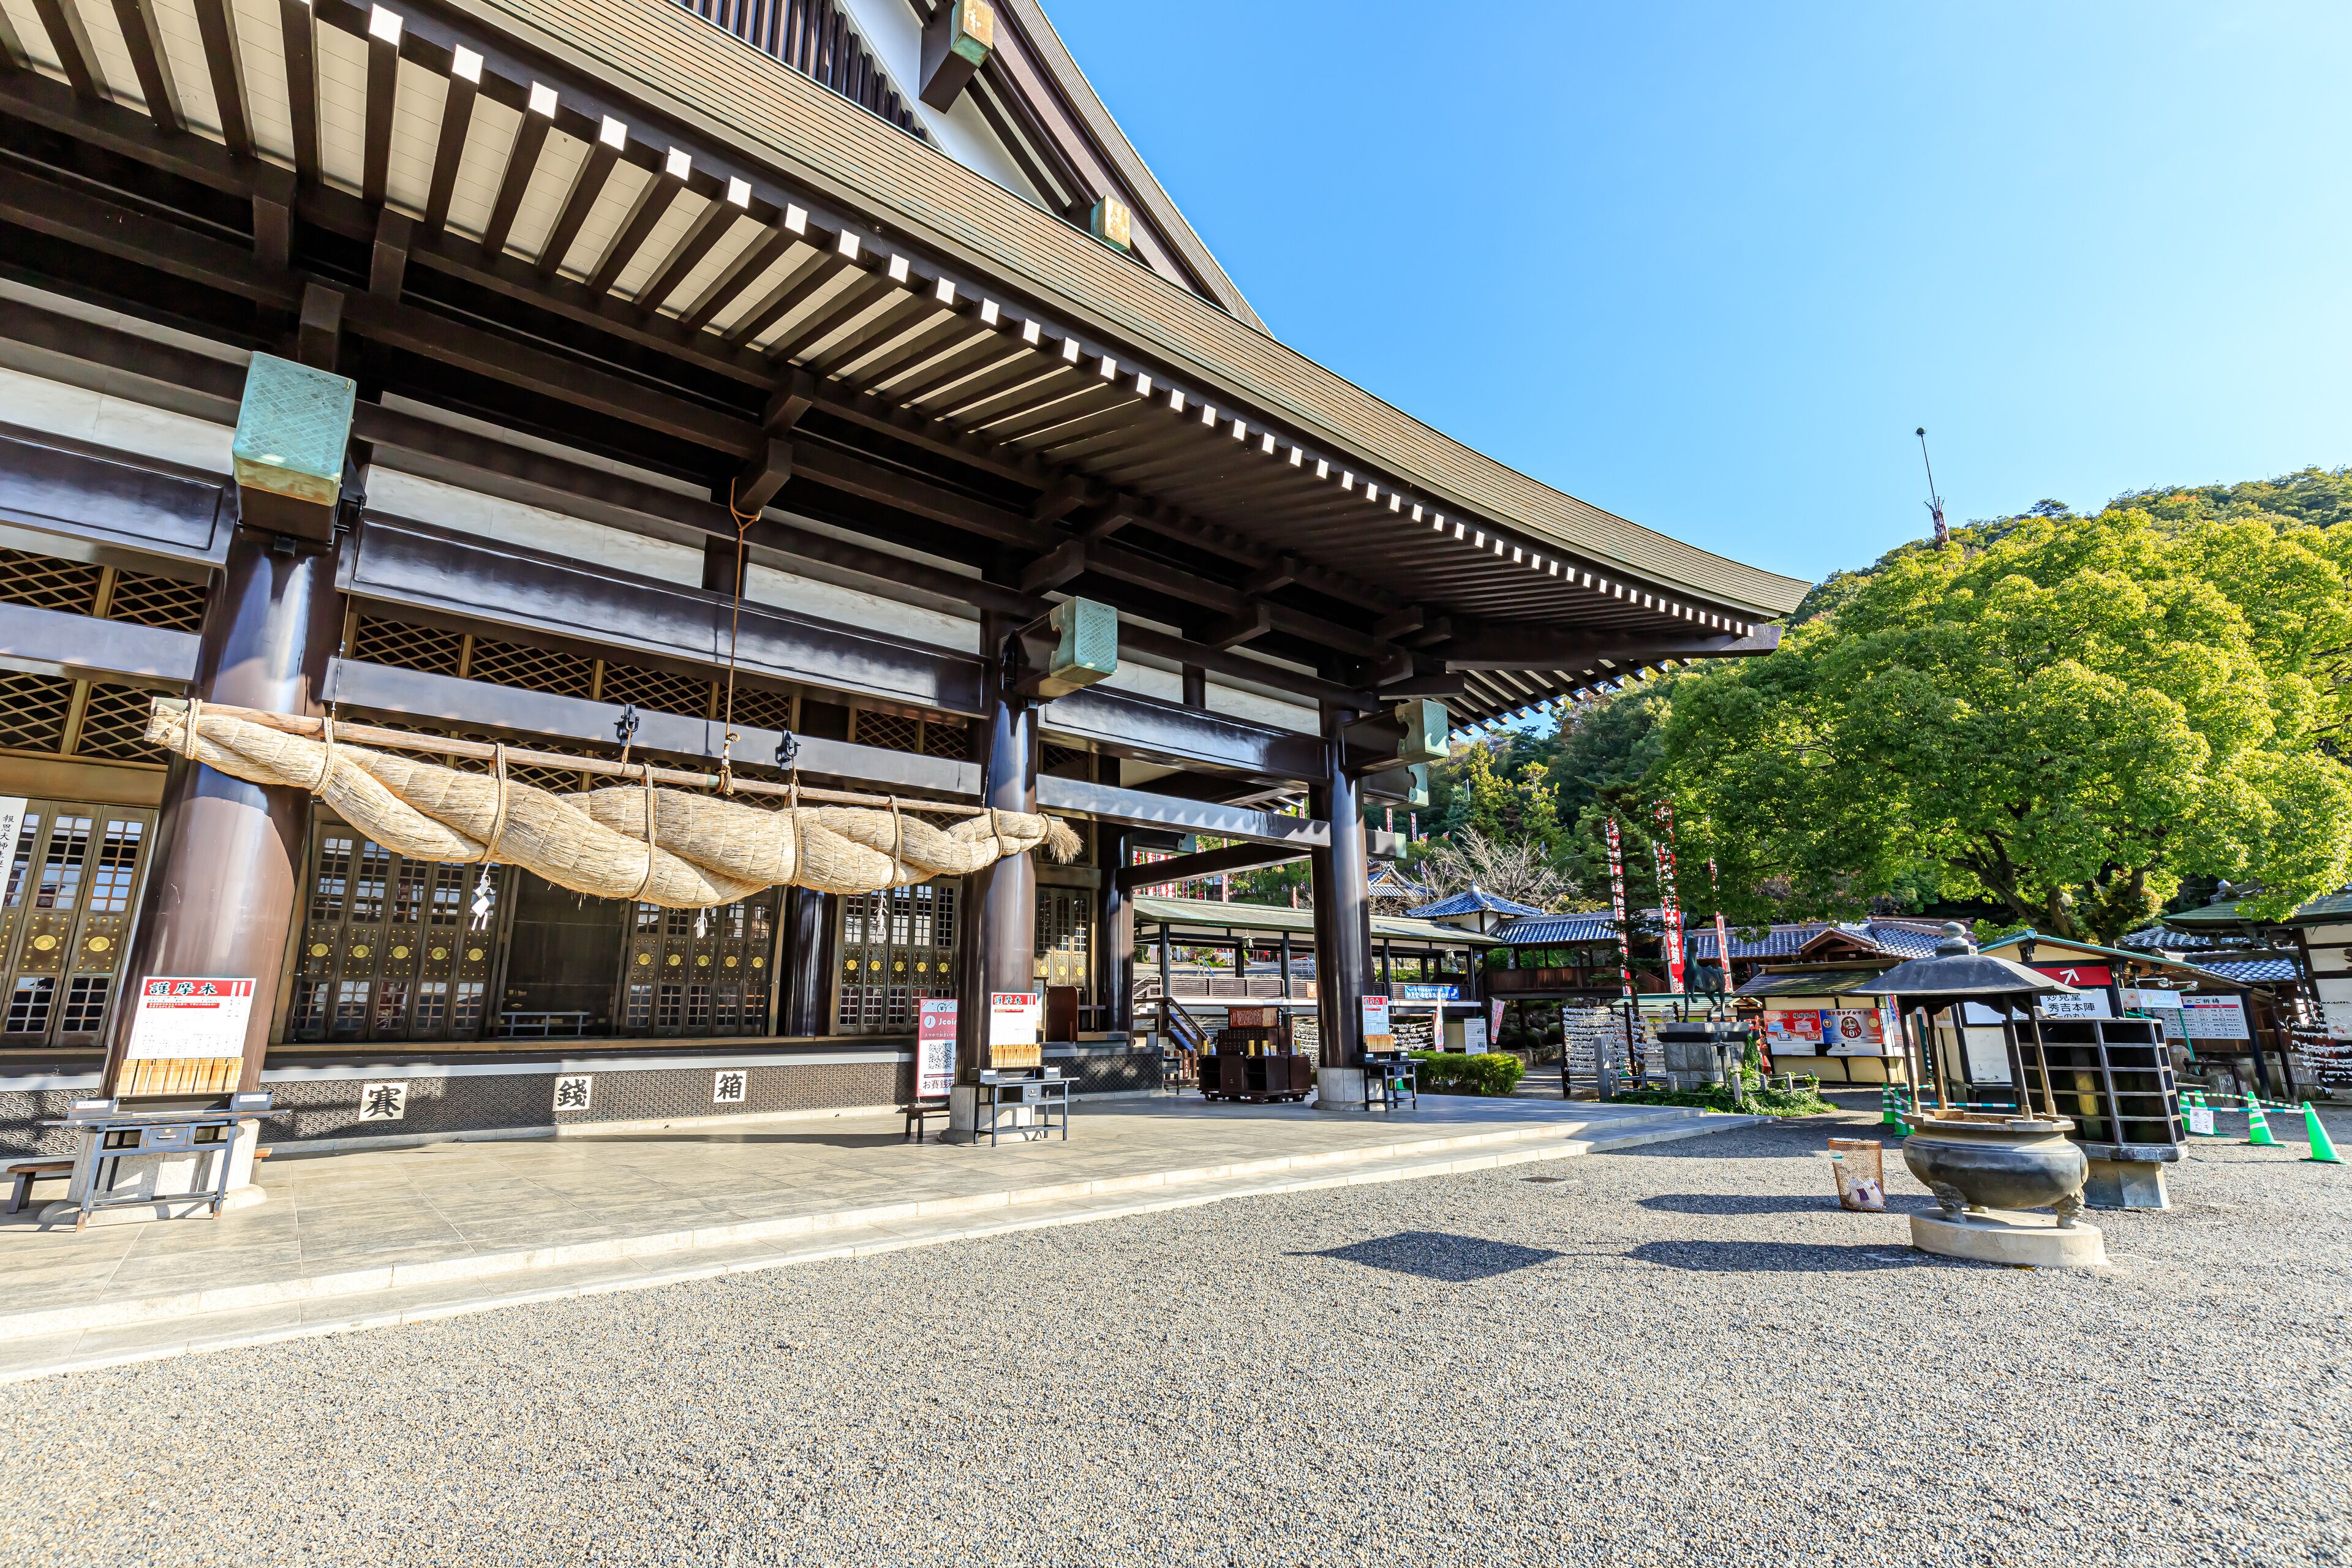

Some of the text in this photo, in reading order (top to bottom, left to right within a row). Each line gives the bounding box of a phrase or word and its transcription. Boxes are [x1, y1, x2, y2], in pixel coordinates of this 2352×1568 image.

[150, 982, 216, 995] 護摩木
[994, 996, 1022, 1005] 護摩木
[2046, 992, 2082, 1001] 妙見堂
[2048, 1003, 2095, 1012] 秀吉本陣
[364, 1085, 402, 1118] 賽
[717, 1072, 744, 1100] 箱
